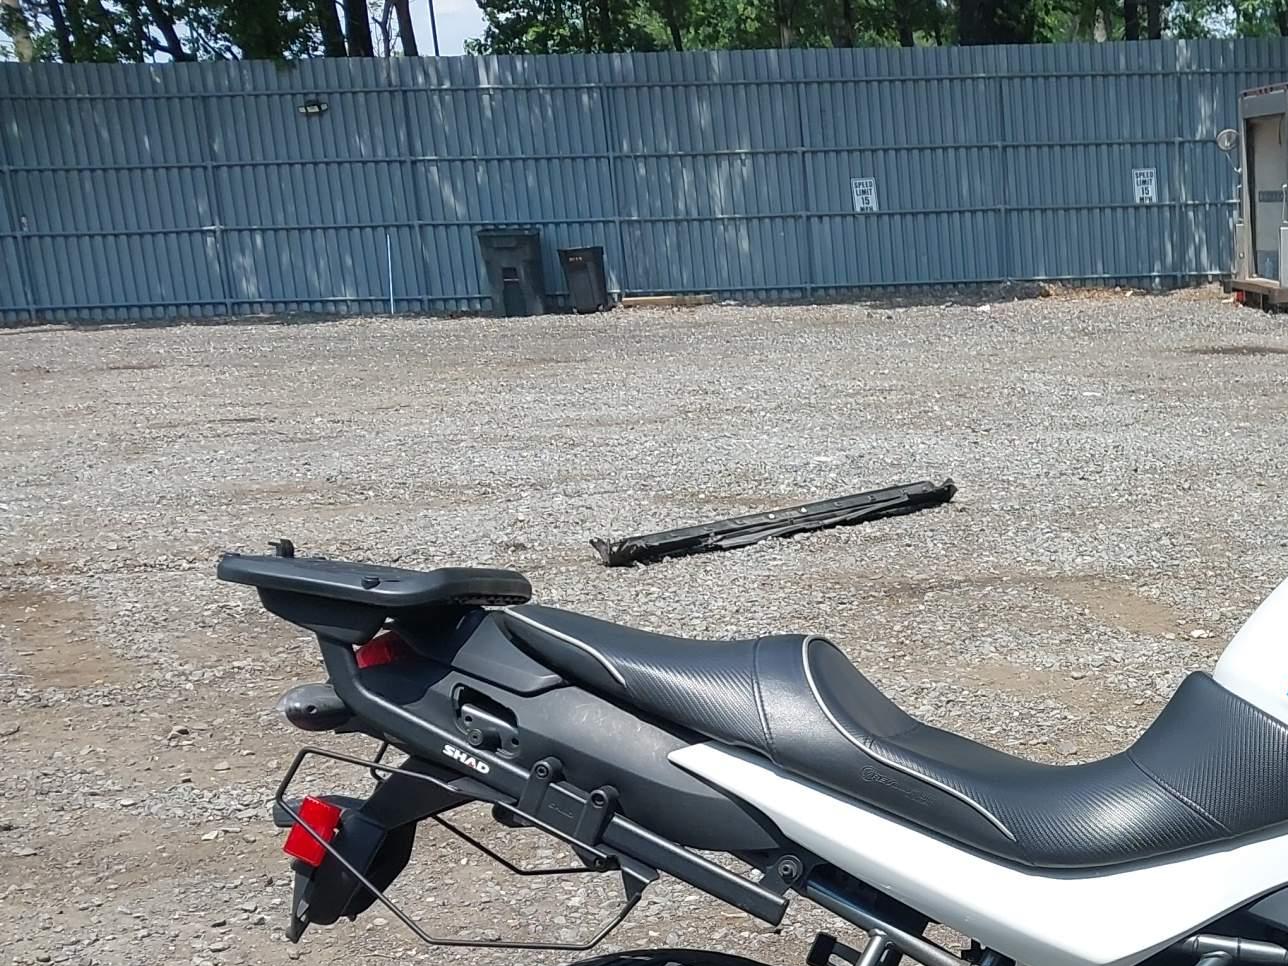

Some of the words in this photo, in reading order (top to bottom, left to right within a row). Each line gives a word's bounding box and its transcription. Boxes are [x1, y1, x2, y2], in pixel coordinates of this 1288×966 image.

[1136, 178, 1152, 186] LIMIT
[855, 188, 872, 196] LIMIT
[1142, 186, 1149, 195] 15
[861, 196, 869, 205] 15
[442, 744, 490, 774] SHAD
